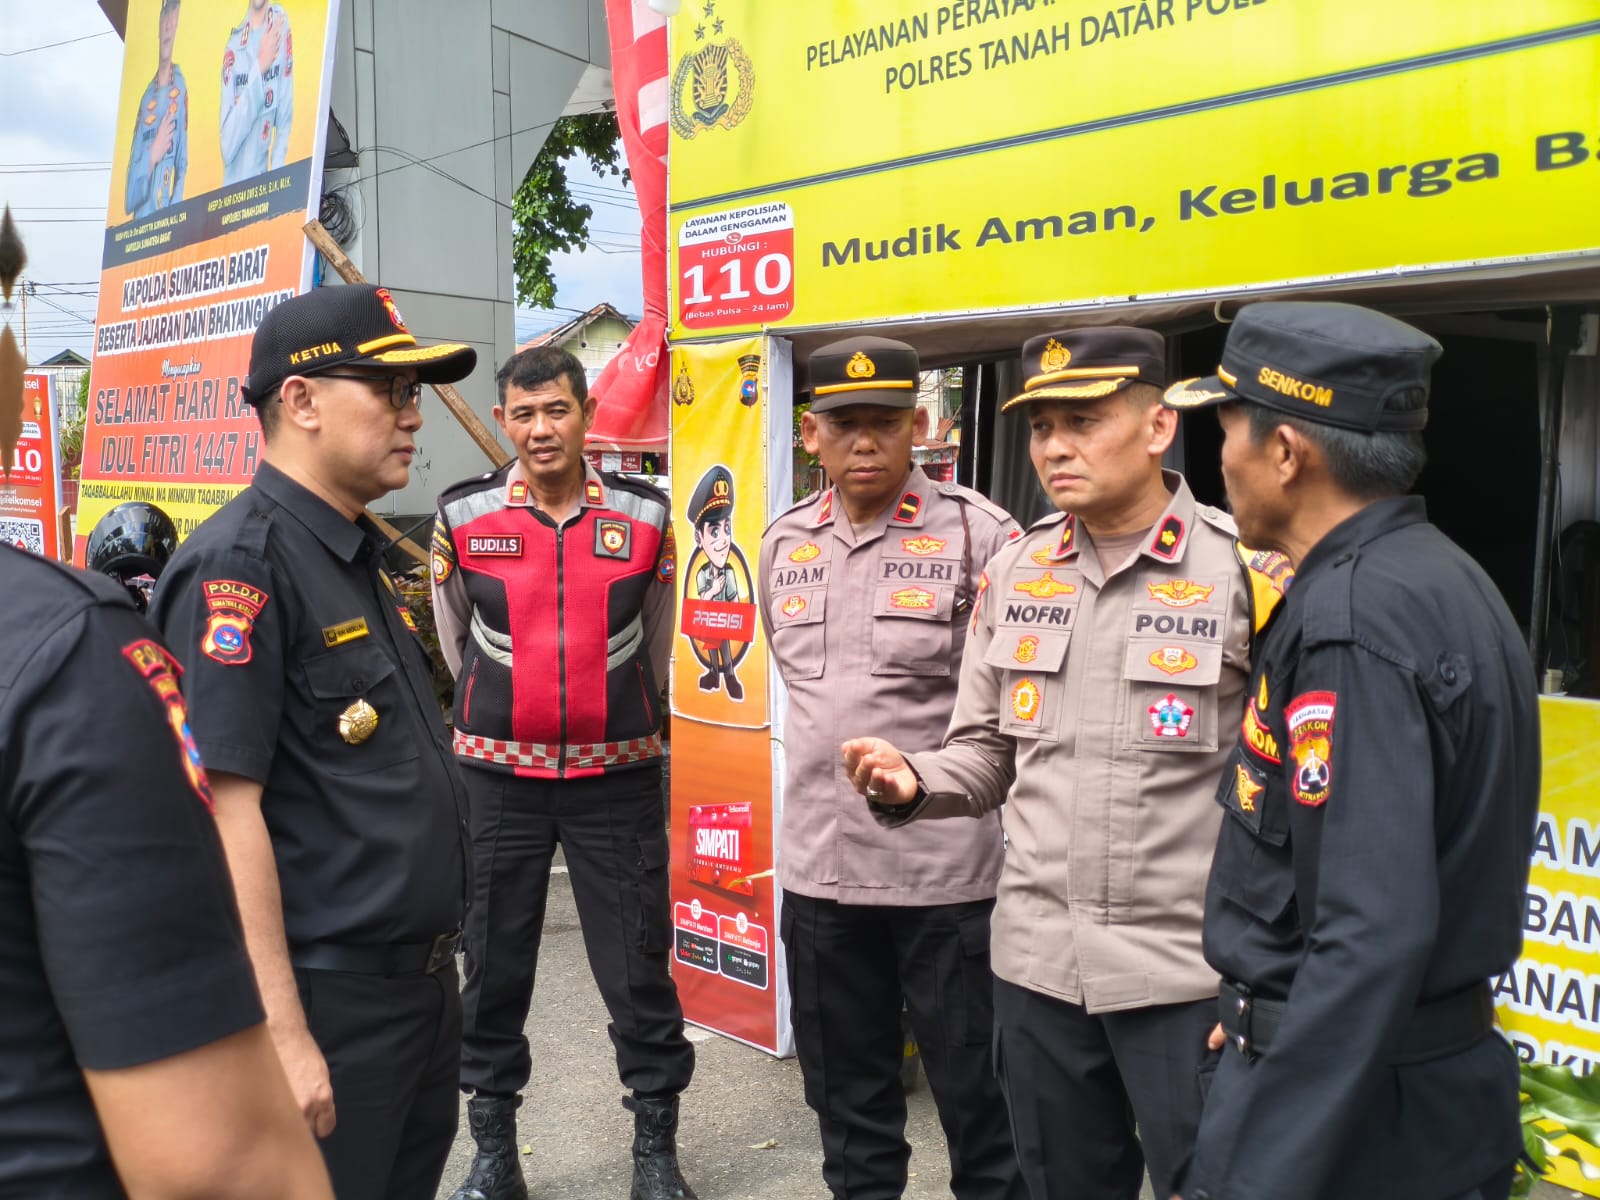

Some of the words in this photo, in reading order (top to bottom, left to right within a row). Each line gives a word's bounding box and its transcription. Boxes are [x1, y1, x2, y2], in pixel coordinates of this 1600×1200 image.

[807, 12, 928, 71] PELAYANAN
[886, 48, 971, 93] POLRES
[979, 22, 1069, 70] TANAH
[1081, 0, 1174, 46] DATAR
[822, 224, 962, 267] Mudik
[976, 205, 1155, 247] Aman,
[1179, 152, 1499, 221] Keluarga
[1536, 132, 1600, 172] B
[685, 214, 727, 228] LAYANAN
[729, 203, 786, 220] KEPOLISIAN
[685, 228, 718, 238] DALAM
[721, 214, 787, 231] GENGGAMAN
[702, 242, 760, 258] HUBUNGI
[122, 271, 167, 309] KAPOLDA
[168, 257, 225, 298] SUMATERA
[228, 248, 268, 285] BARAT
[684, 253, 791, 305] 110
[685, 311, 715, 320] (Bebas
[717, 307, 741, 316] Pulsa
[752, 304, 763, 312] 24
[766, 301, 789, 311] Jam)
[98, 324, 136, 352] BESERTA
[138, 314, 180, 346] JAJARAN
[183, 308, 206, 341] DAN
[290, 341, 342, 365] KETUA
[1258, 367, 1333, 407] SENKOM
[95, 383, 171, 425] SELAMAT
[173, 377, 220, 421] HARI
[99, 436, 136, 473] IDUL
[141, 433, 188, 475] FITRI
[194, 432, 239, 475] 1447
[242, 431, 260, 475] H
[168, 488, 196, 504] MINKUM
[775, 566, 824, 588] ADAM
[883, 562, 953, 580] POLRI
[209, 583, 260, 602] POLDA
[1005, 604, 1071, 625] NOFRI
[1136, 614, 1217, 638] POLRI
[696, 828, 739, 860] SIMPATI
